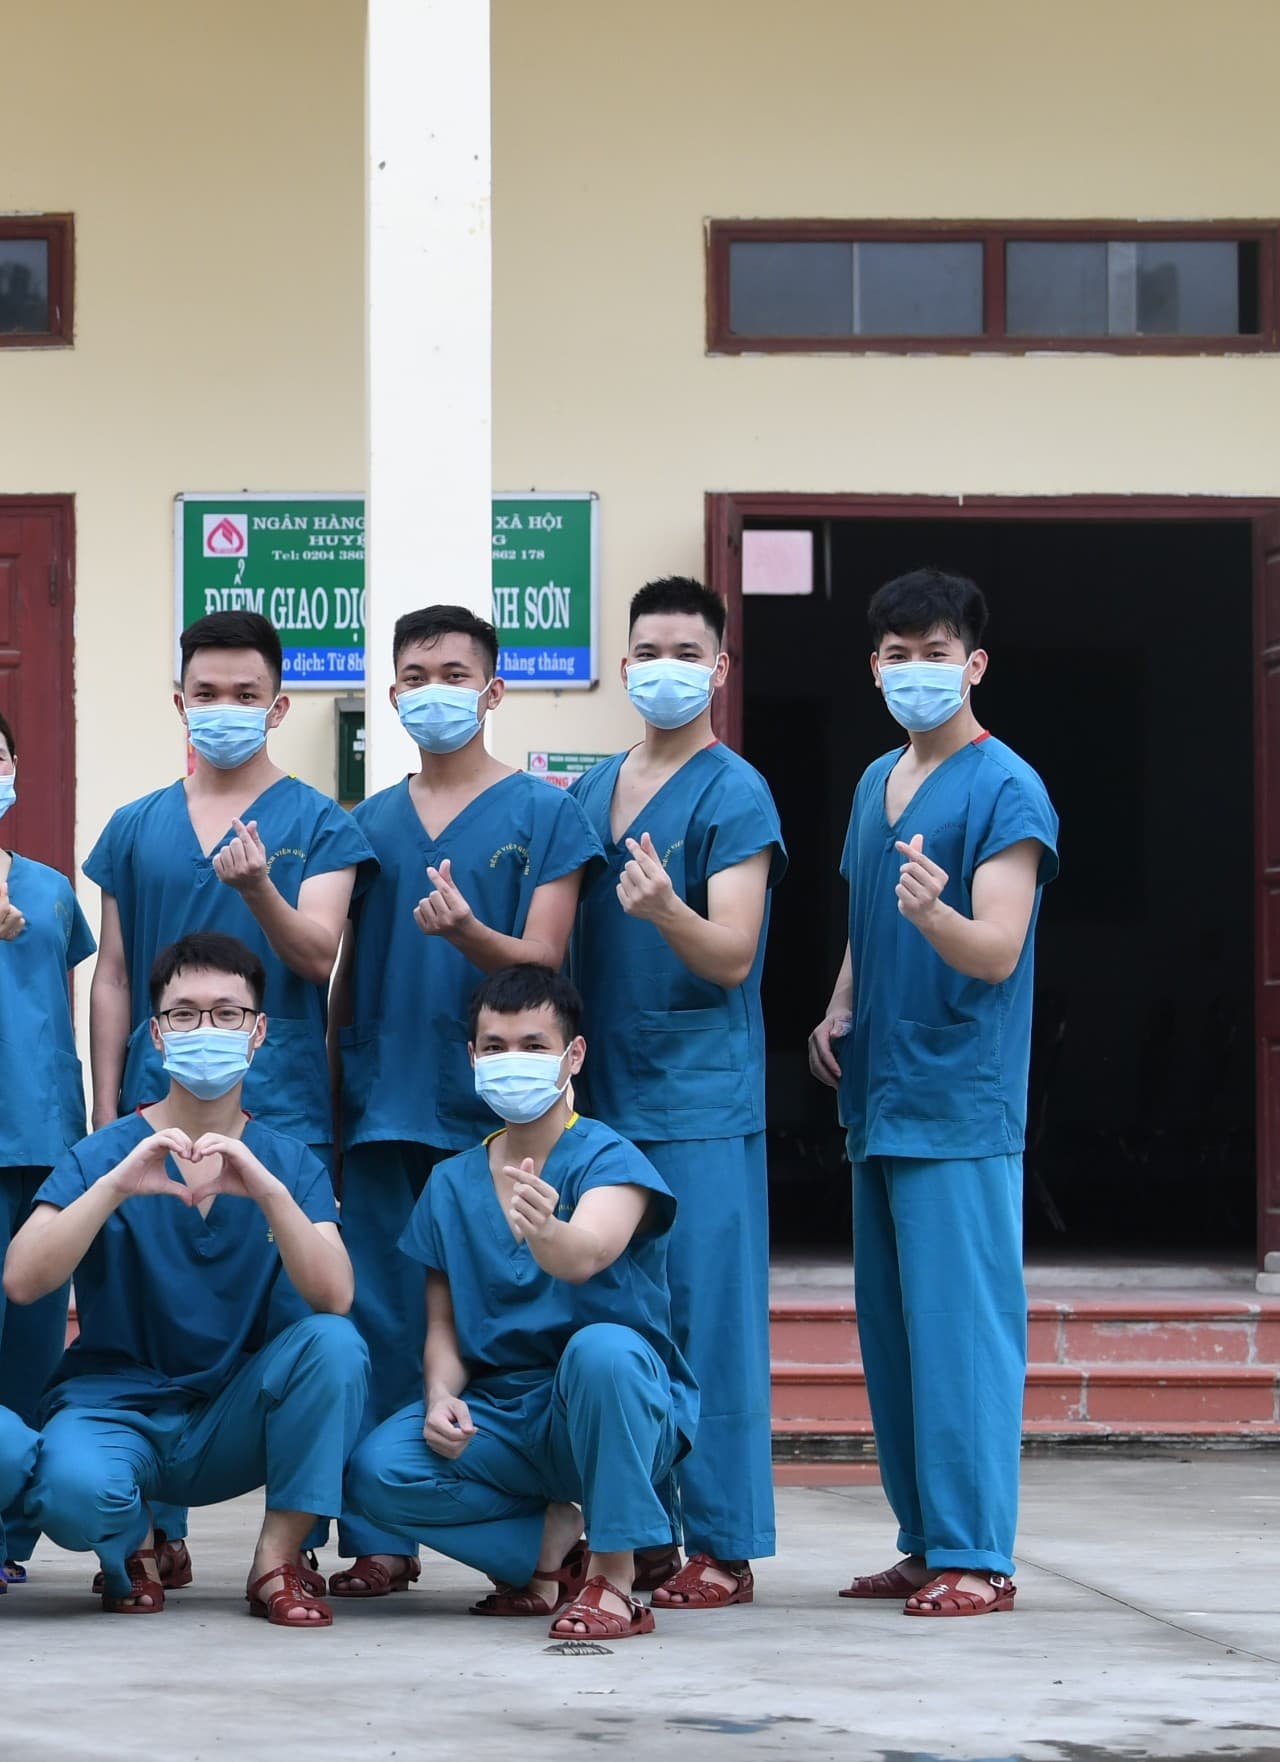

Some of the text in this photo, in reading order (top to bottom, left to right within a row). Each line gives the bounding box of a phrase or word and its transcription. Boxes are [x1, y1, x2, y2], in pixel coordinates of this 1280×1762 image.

[253, 513, 308, 530] NGÂN
[495, 512, 563, 532] XÃ HỘI
[272, 550, 299, 560] Tel:
[303, 550, 334, 560] 0204
[521, 550, 545, 560] 178
[271, 587, 328, 629] GIAO
[525, 580, 571, 629] SƠN
[293, 652, 325, 676] dịch:
[328, 653, 344, 671] Từ
[503, 652, 535, 675] hàng
[538, 652, 574, 675] tháng
